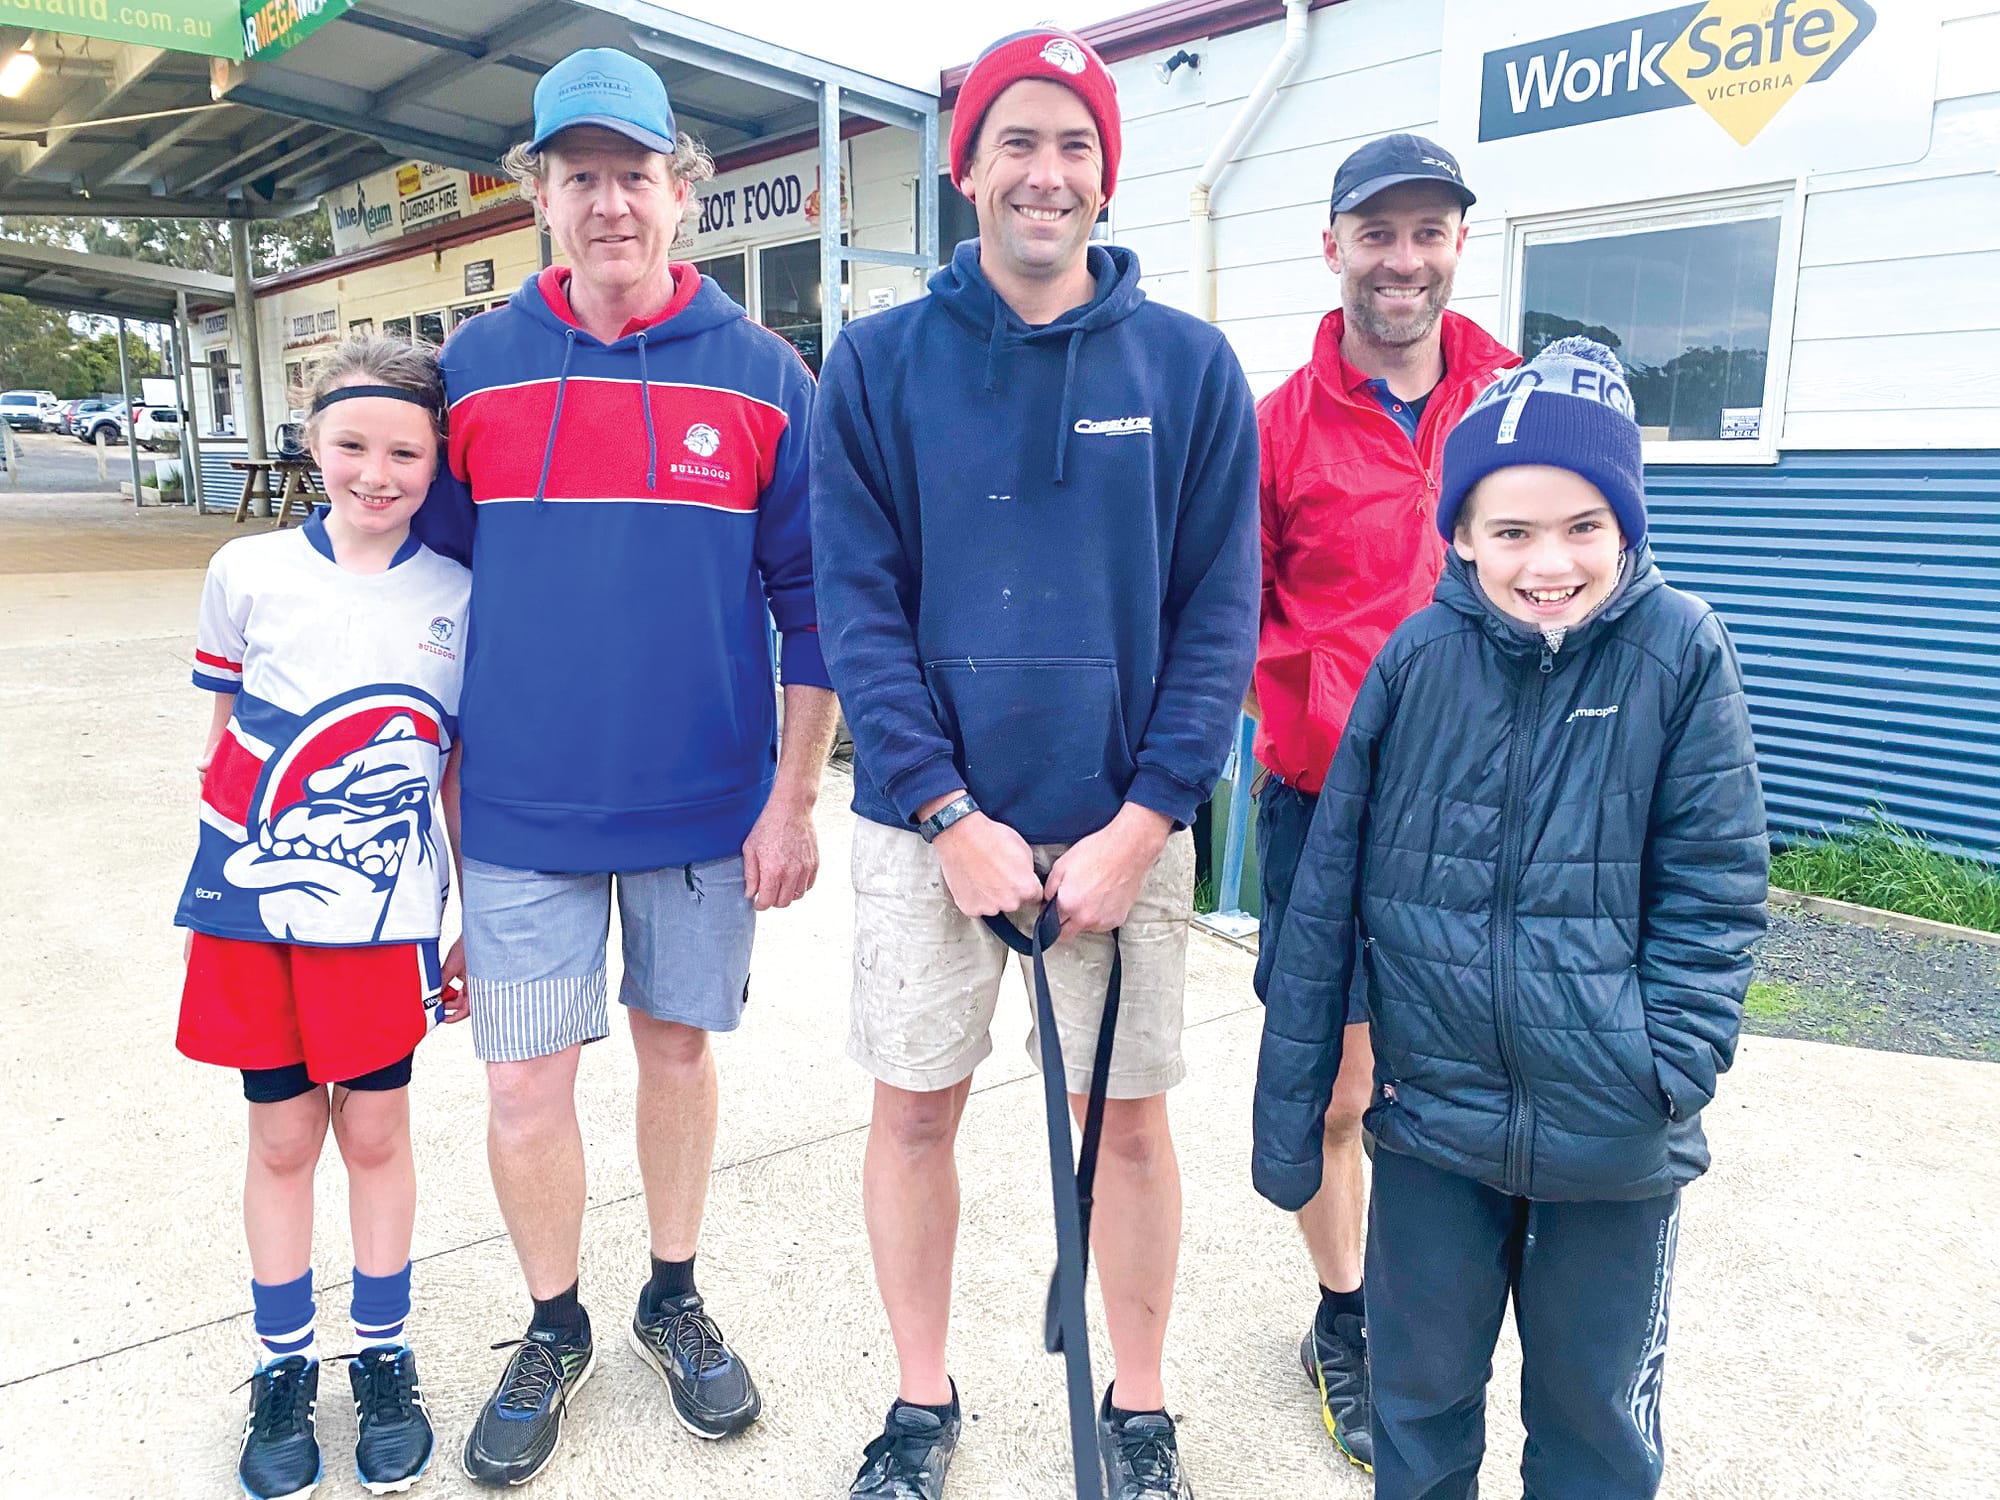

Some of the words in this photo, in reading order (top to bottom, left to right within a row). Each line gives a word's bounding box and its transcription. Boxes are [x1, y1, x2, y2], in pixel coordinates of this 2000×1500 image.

[1707, 74, 1793, 101] VICTORIA
[697, 190, 736, 234] HOT
[743, 175, 802, 224] FOOD
[335, 205, 357, 229] blue
[368, 204, 392, 234] gum
[670, 464, 730, 480] BULLDOGS
